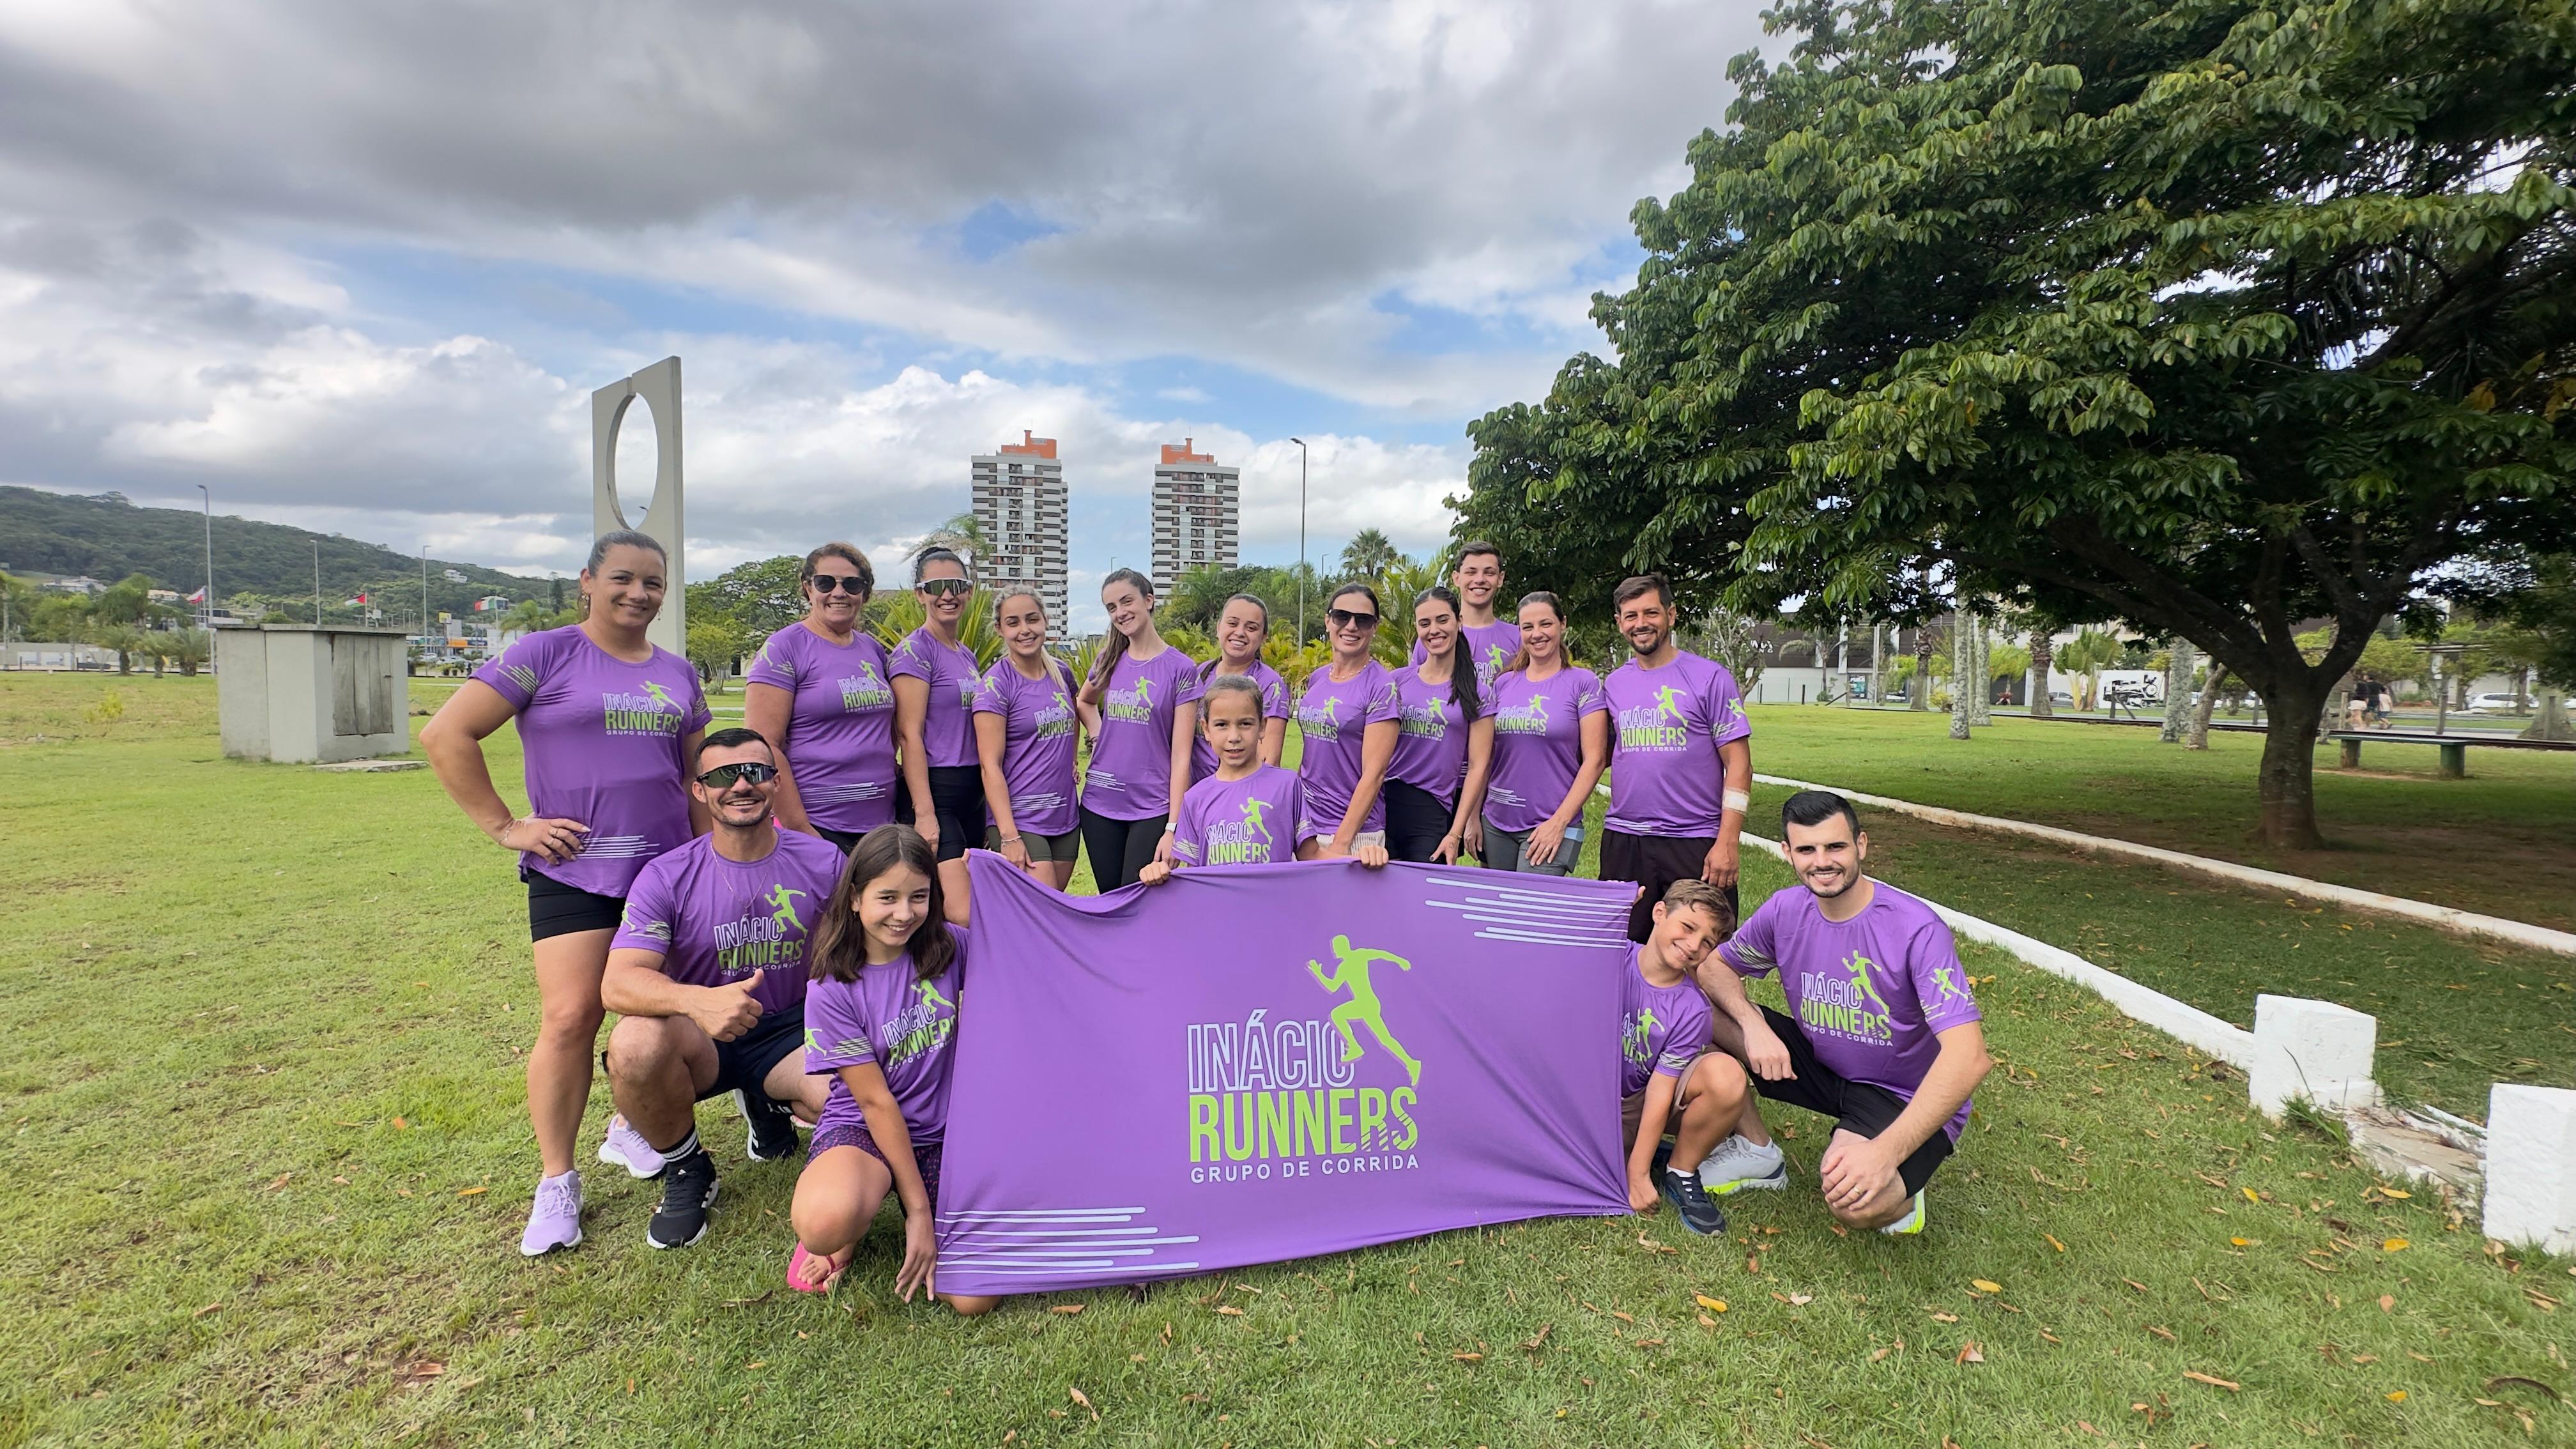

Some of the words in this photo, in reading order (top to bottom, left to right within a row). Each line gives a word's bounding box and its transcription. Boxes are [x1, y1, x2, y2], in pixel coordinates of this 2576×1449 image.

[602, 692, 664, 714] INÁCIO
[843, 690, 894, 709] RUNNERS
[604, 710, 682, 733] RUNNERS
[1107, 703, 1151, 721] RUNNERS
[1495, 716, 1547, 732] RUNNERS
[1620, 726, 1687, 747] RUNNERS
[714, 914, 783, 951] INÁCIO
[718, 939, 805, 970] RUNNERS
[721, 967, 749, 977] GRUPO
[882, 1004, 936, 1048] INÁCIO
[1800, 997, 1892, 1040] RUNNERS
[1830, 1028, 1843, 1038] DE
[1846, 1033, 1894, 1046] CORRIDA
[1187, 1008, 1355, 1093] INÁCIO
[1189, 1085, 1418, 1163] RUNNERS
[1190, 1163, 1271, 1183] GRUPO
[1283, 1160, 1310, 1178] DE
[1321, 1154, 1420, 1175] CORRIDA
